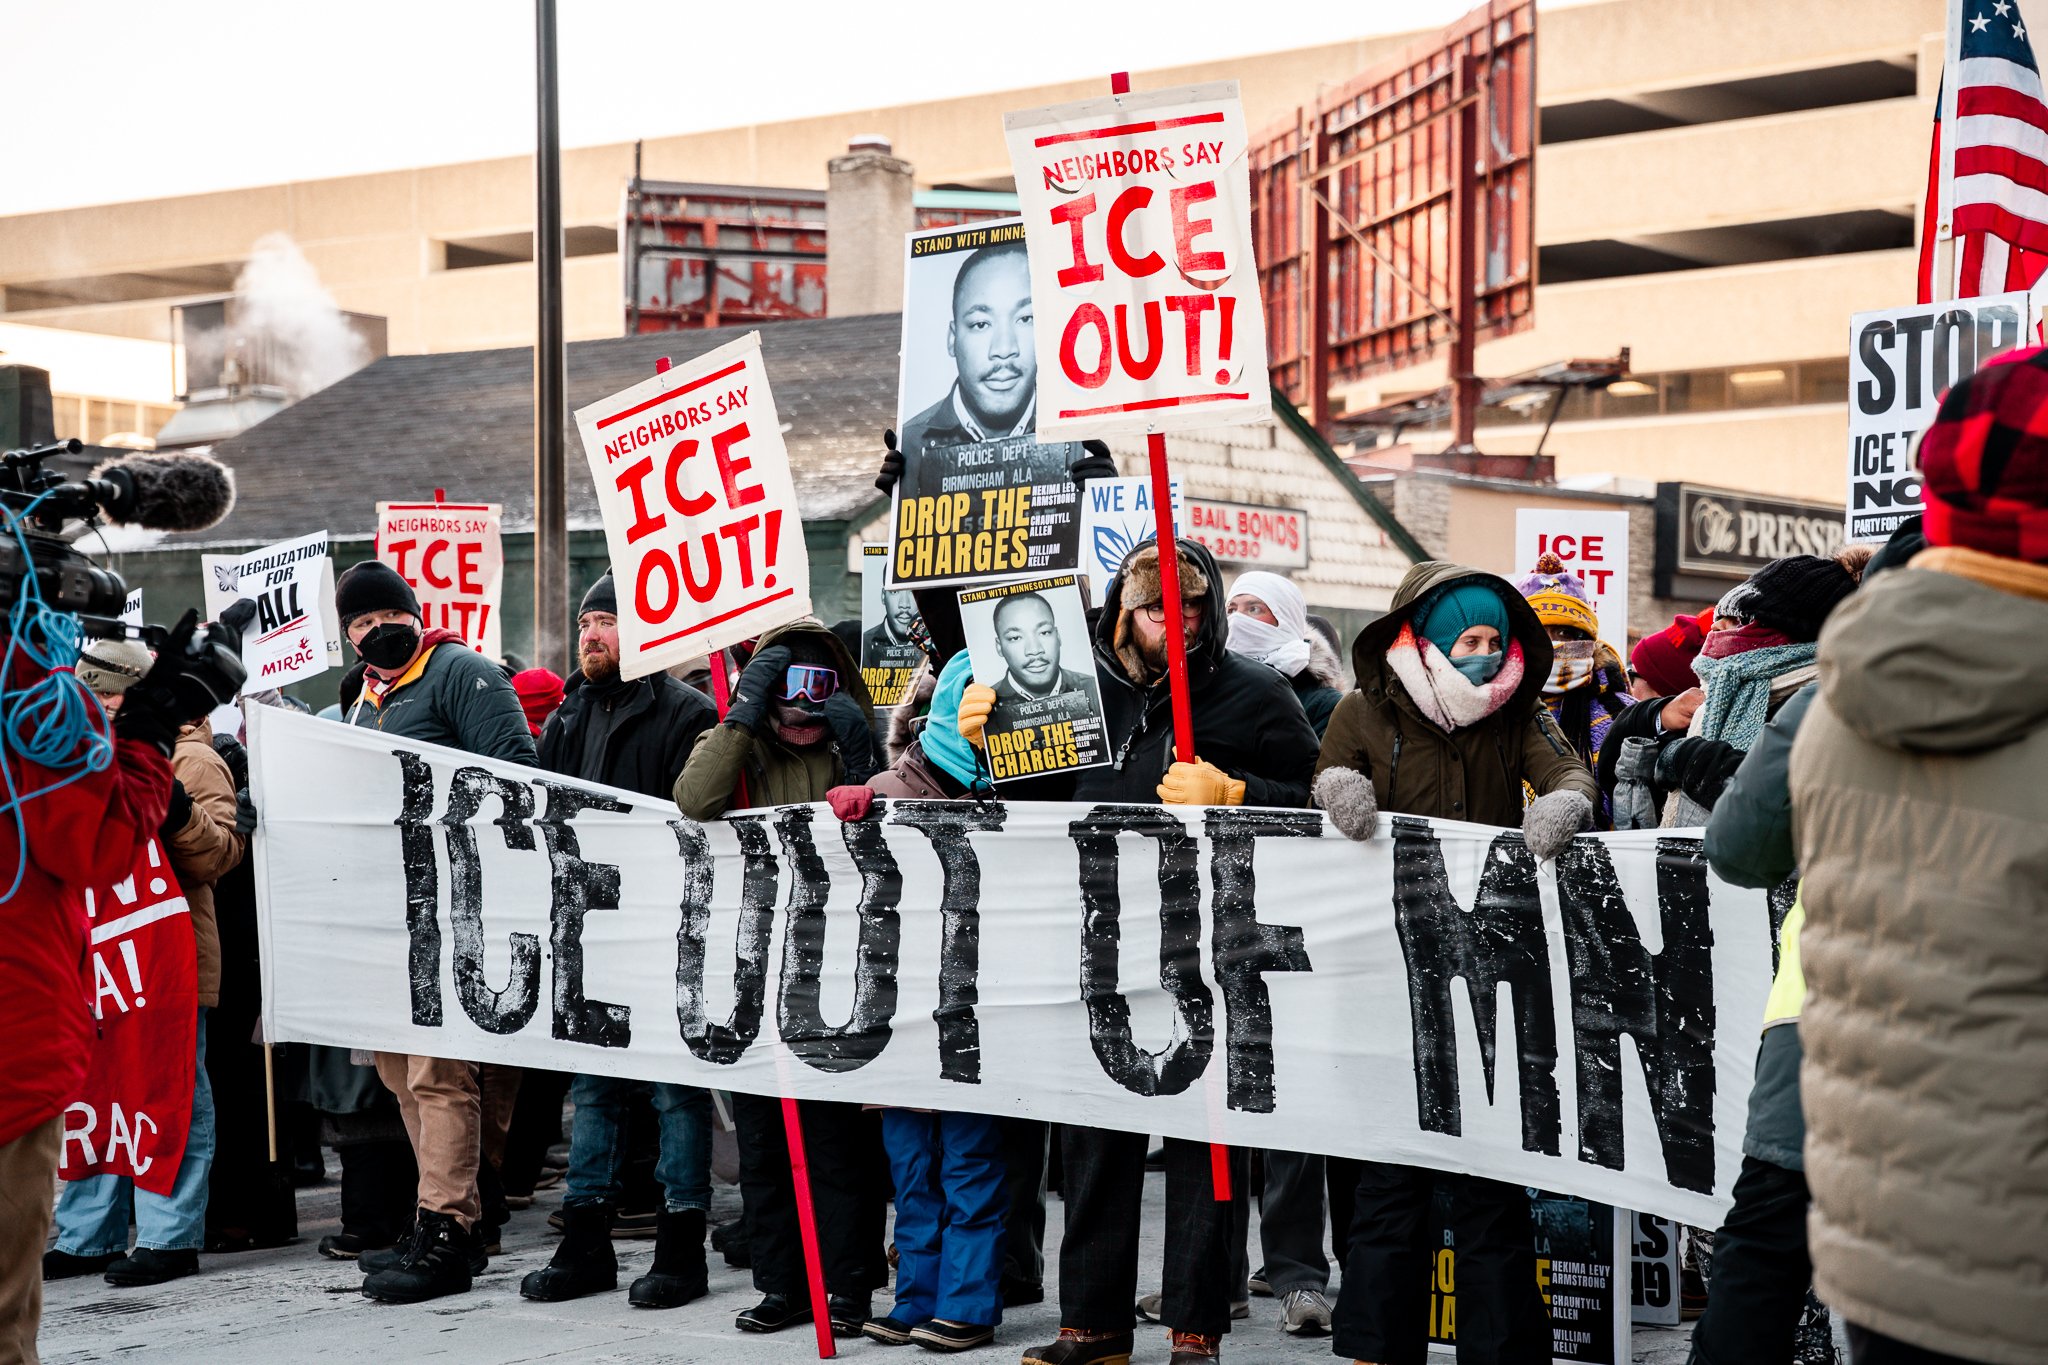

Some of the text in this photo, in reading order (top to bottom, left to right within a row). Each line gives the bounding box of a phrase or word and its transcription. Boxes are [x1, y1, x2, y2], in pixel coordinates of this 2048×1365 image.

[1043, 141, 1224, 190] NEIGHBORS SAY
[915, 225, 1026, 254] STAND WITH MINNE
[1050, 181, 1227, 288] ICE
[1059, 293, 1237, 390] OUT!
[604, 386, 749, 464] NEIGHBORS SAY
[957, 443, 1030, 468] POLICE DEPT
[1853, 432, 1896, 477] ICE
[615, 421, 766, 545] ICE
[942, 467, 1033, 493] BIRMINGHAM ALA
[1032, 481, 1080, 497] NEKIMA LEV
[1853, 477, 1926, 510] NO
[1031, 492, 1076, 507] ARMSTRONG
[1091, 482, 1179, 513] WE AE
[388, 518, 488, 534] NEIGHBORS SAY
[899, 492, 971, 539] DROP
[981, 486, 1031, 531] THE
[1854, 517, 1881, 535] PARTY
[1881, 516, 1898, 531] FOR
[1030, 525, 1053, 537] ALLEN
[1192, 506, 1299, 552] BAIL BONDS
[239, 541, 326, 578] LEGALIZATION
[896, 528, 1029, 580] CHARGES
[1028, 543, 1061, 556] WILLIAM
[1538, 534, 1604, 561] ICE
[388, 539, 484, 595] ICE
[634, 509, 783, 625] OUT!
[1028, 555, 1050, 568] KELLY
[265, 566, 294, 588] FOR
[962, 576, 1075, 603] STAND WITH MINNESOTA NOW!
[257, 582, 304, 635] ALL
[422, 602, 491, 653] UT!
[261, 649, 314, 677] MIRAC
[862, 667, 891, 687] DROP
[893, 667, 913, 687] THE
[868, 686, 908, 705] HARGES
[1020, 699, 1067, 716] POLICE DEPT
[1013, 711, 1072, 730] BIRMINGHAM ALA
[988, 728, 1036, 757] DROP
[1040, 721, 1076, 747] THE
[992, 744, 1079, 778] CHARGES
[391, 748, 1717, 1196] ICE OUT OF MN
[59, 1101, 158, 1177] RAC
[1552, 1260, 1611, 1278] NEKIMA LEVY
[1552, 1272, 1606, 1289] ARMSTRONG
[1552, 1294, 1602, 1311] CHAUNTYLL
[1552, 1306, 1579, 1321] ALLEN
[1553, 1328, 1591, 1345] WILLIAM
[1553, 1340, 1578, 1355] KELLY
